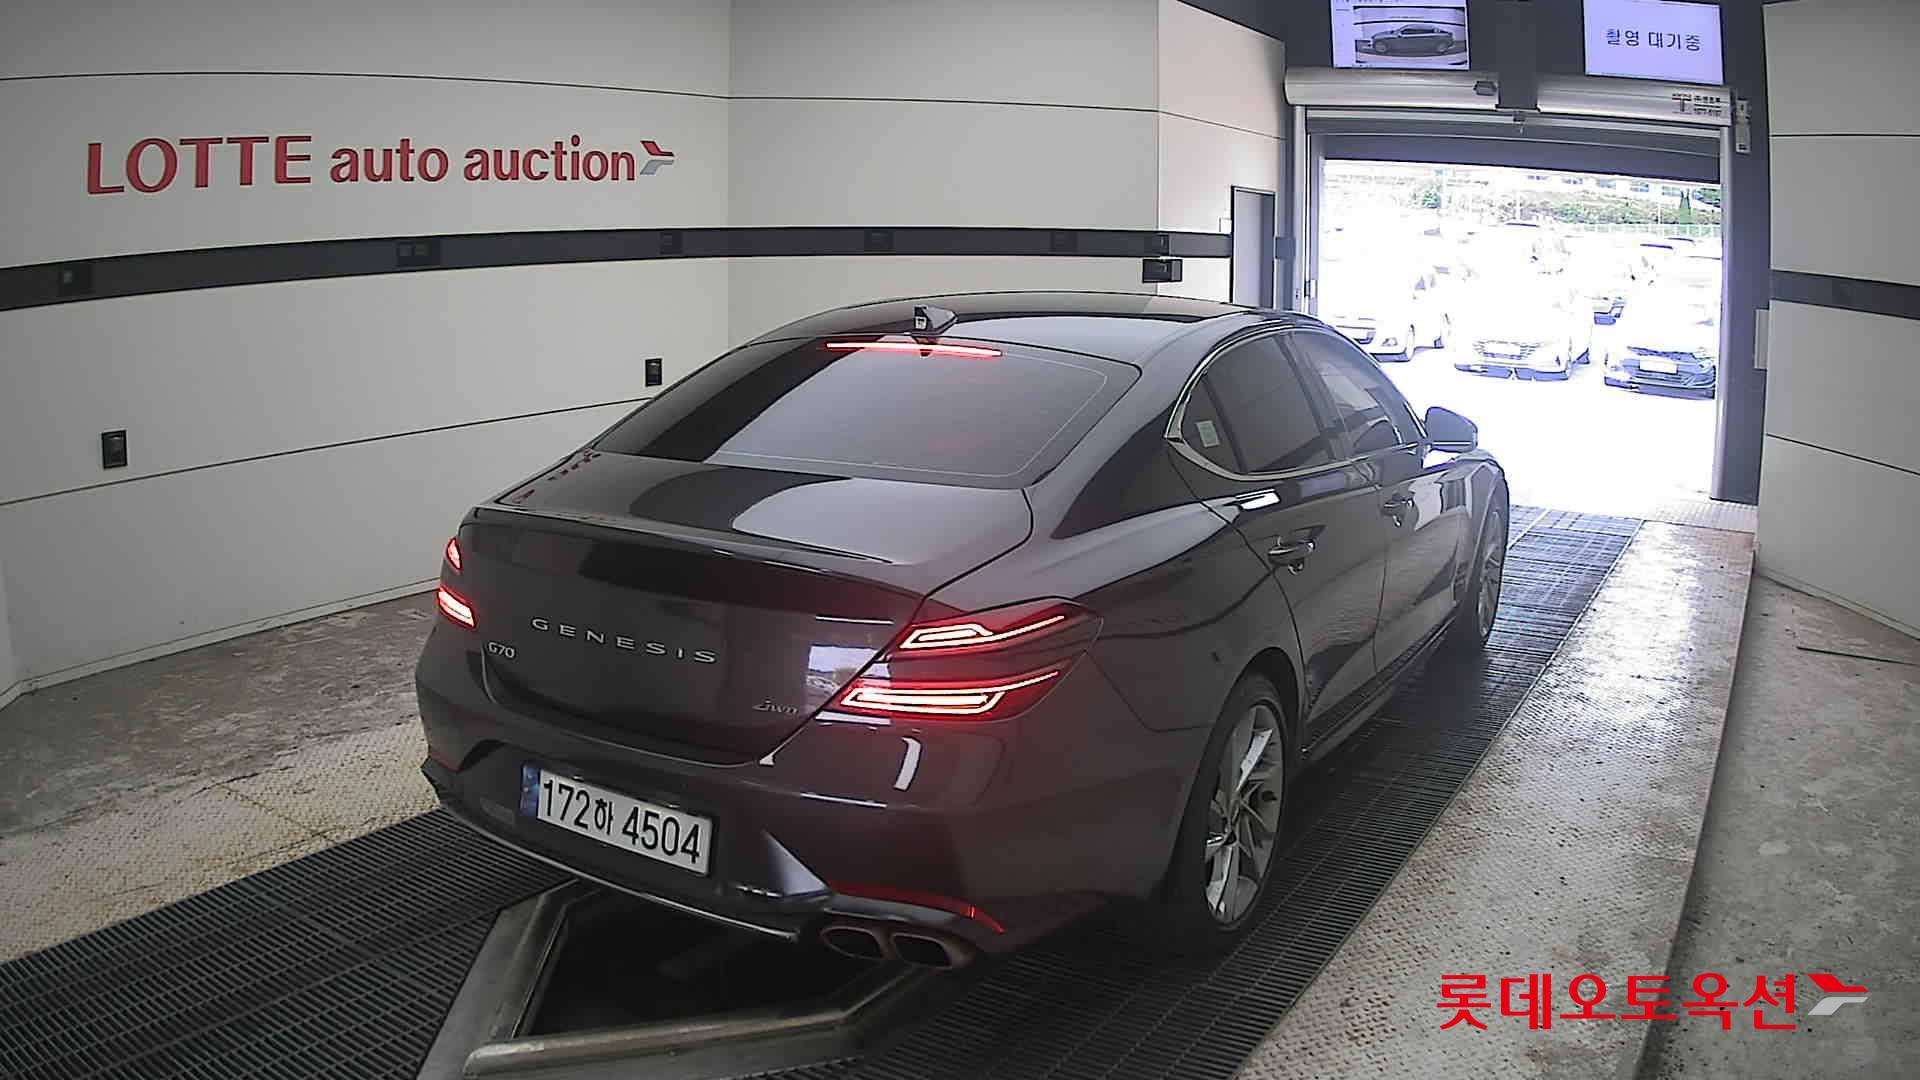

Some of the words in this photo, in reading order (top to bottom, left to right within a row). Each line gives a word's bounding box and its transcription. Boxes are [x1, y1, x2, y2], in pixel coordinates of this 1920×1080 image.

[1606, 28, 1640, 47] 촬영
[1647, 31, 1701, 52] 대기중
[86, 134, 312, 195] LOTTE
[329, 138, 450, 184] auto
[463, 134, 637, 183] auction
[488, 641, 516, 659] G70
[531, 617, 717, 664] GENESIS
[543, 779, 615, 836] 172하
[621, 806, 701, 865] 4504
